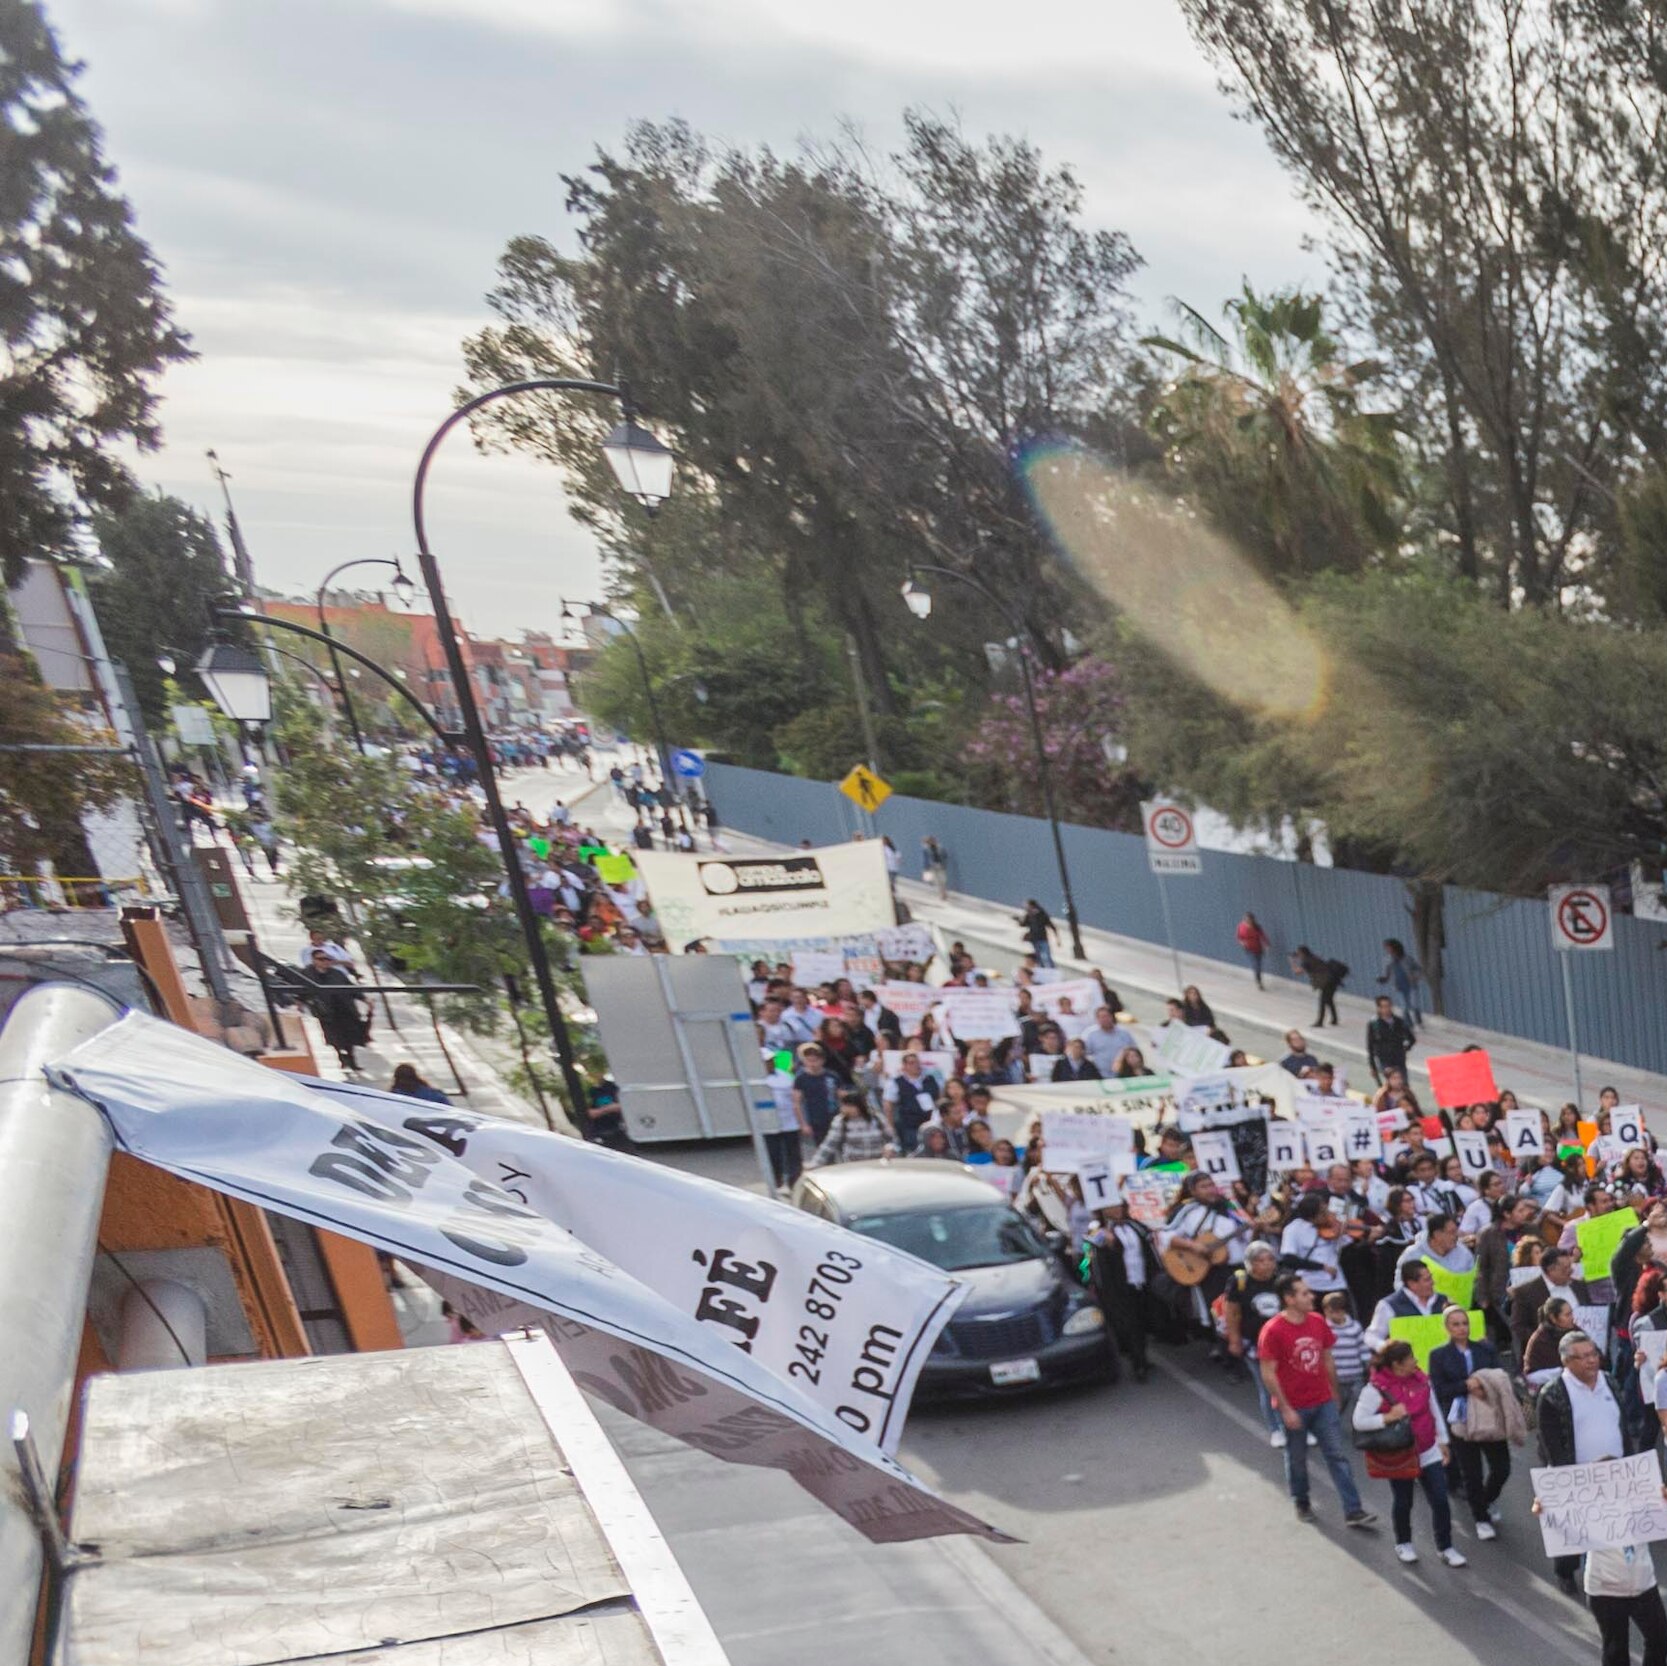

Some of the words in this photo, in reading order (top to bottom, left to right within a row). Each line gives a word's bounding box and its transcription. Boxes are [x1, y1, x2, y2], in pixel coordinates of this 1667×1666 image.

[1158, 815, 1182, 834] 40
[1353, 1128, 1372, 1150] #
[1517, 1127, 1538, 1148] A
[1619, 1123, 1640, 1143] Q
[1277, 1146, 1293, 1161] n
[1317, 1144, 1335, 1161] a
[1465, 1149, 1488, 1169] U
[1088, 1175, 1108, 1198] T
[805, 1250, 863, 1320] 8703
[692, 1248, 778, 1353] FÉ
[788, 1325, 829, 1386] 242
[851, 1324, 904, 1401] pm
[1538, 1456, 1651, 1491] GOBIERNO
[1564, 1526, 1589, 1546] LA
